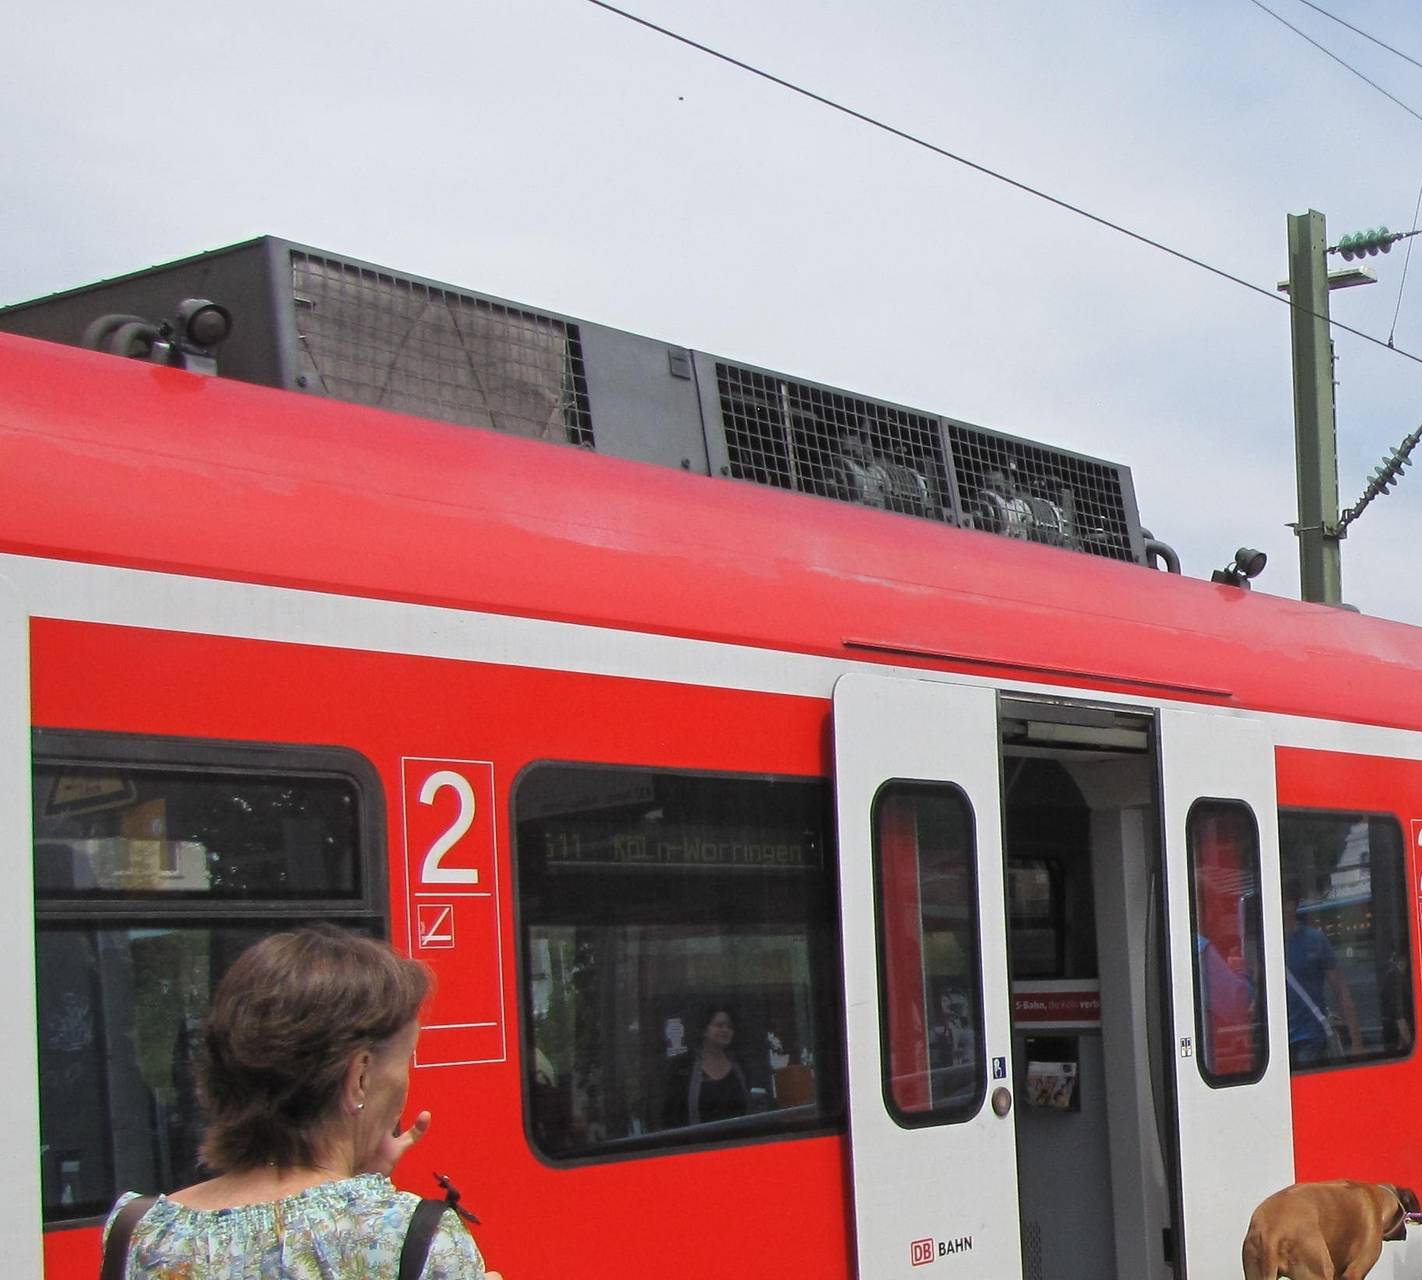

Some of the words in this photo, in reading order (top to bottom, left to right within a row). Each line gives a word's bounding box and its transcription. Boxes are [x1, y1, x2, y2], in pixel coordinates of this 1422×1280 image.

[419, 770, 479, 884] 2
[913, 1241, 932, 1263] DB
[938, 1236, 973, 1257] BAHN
